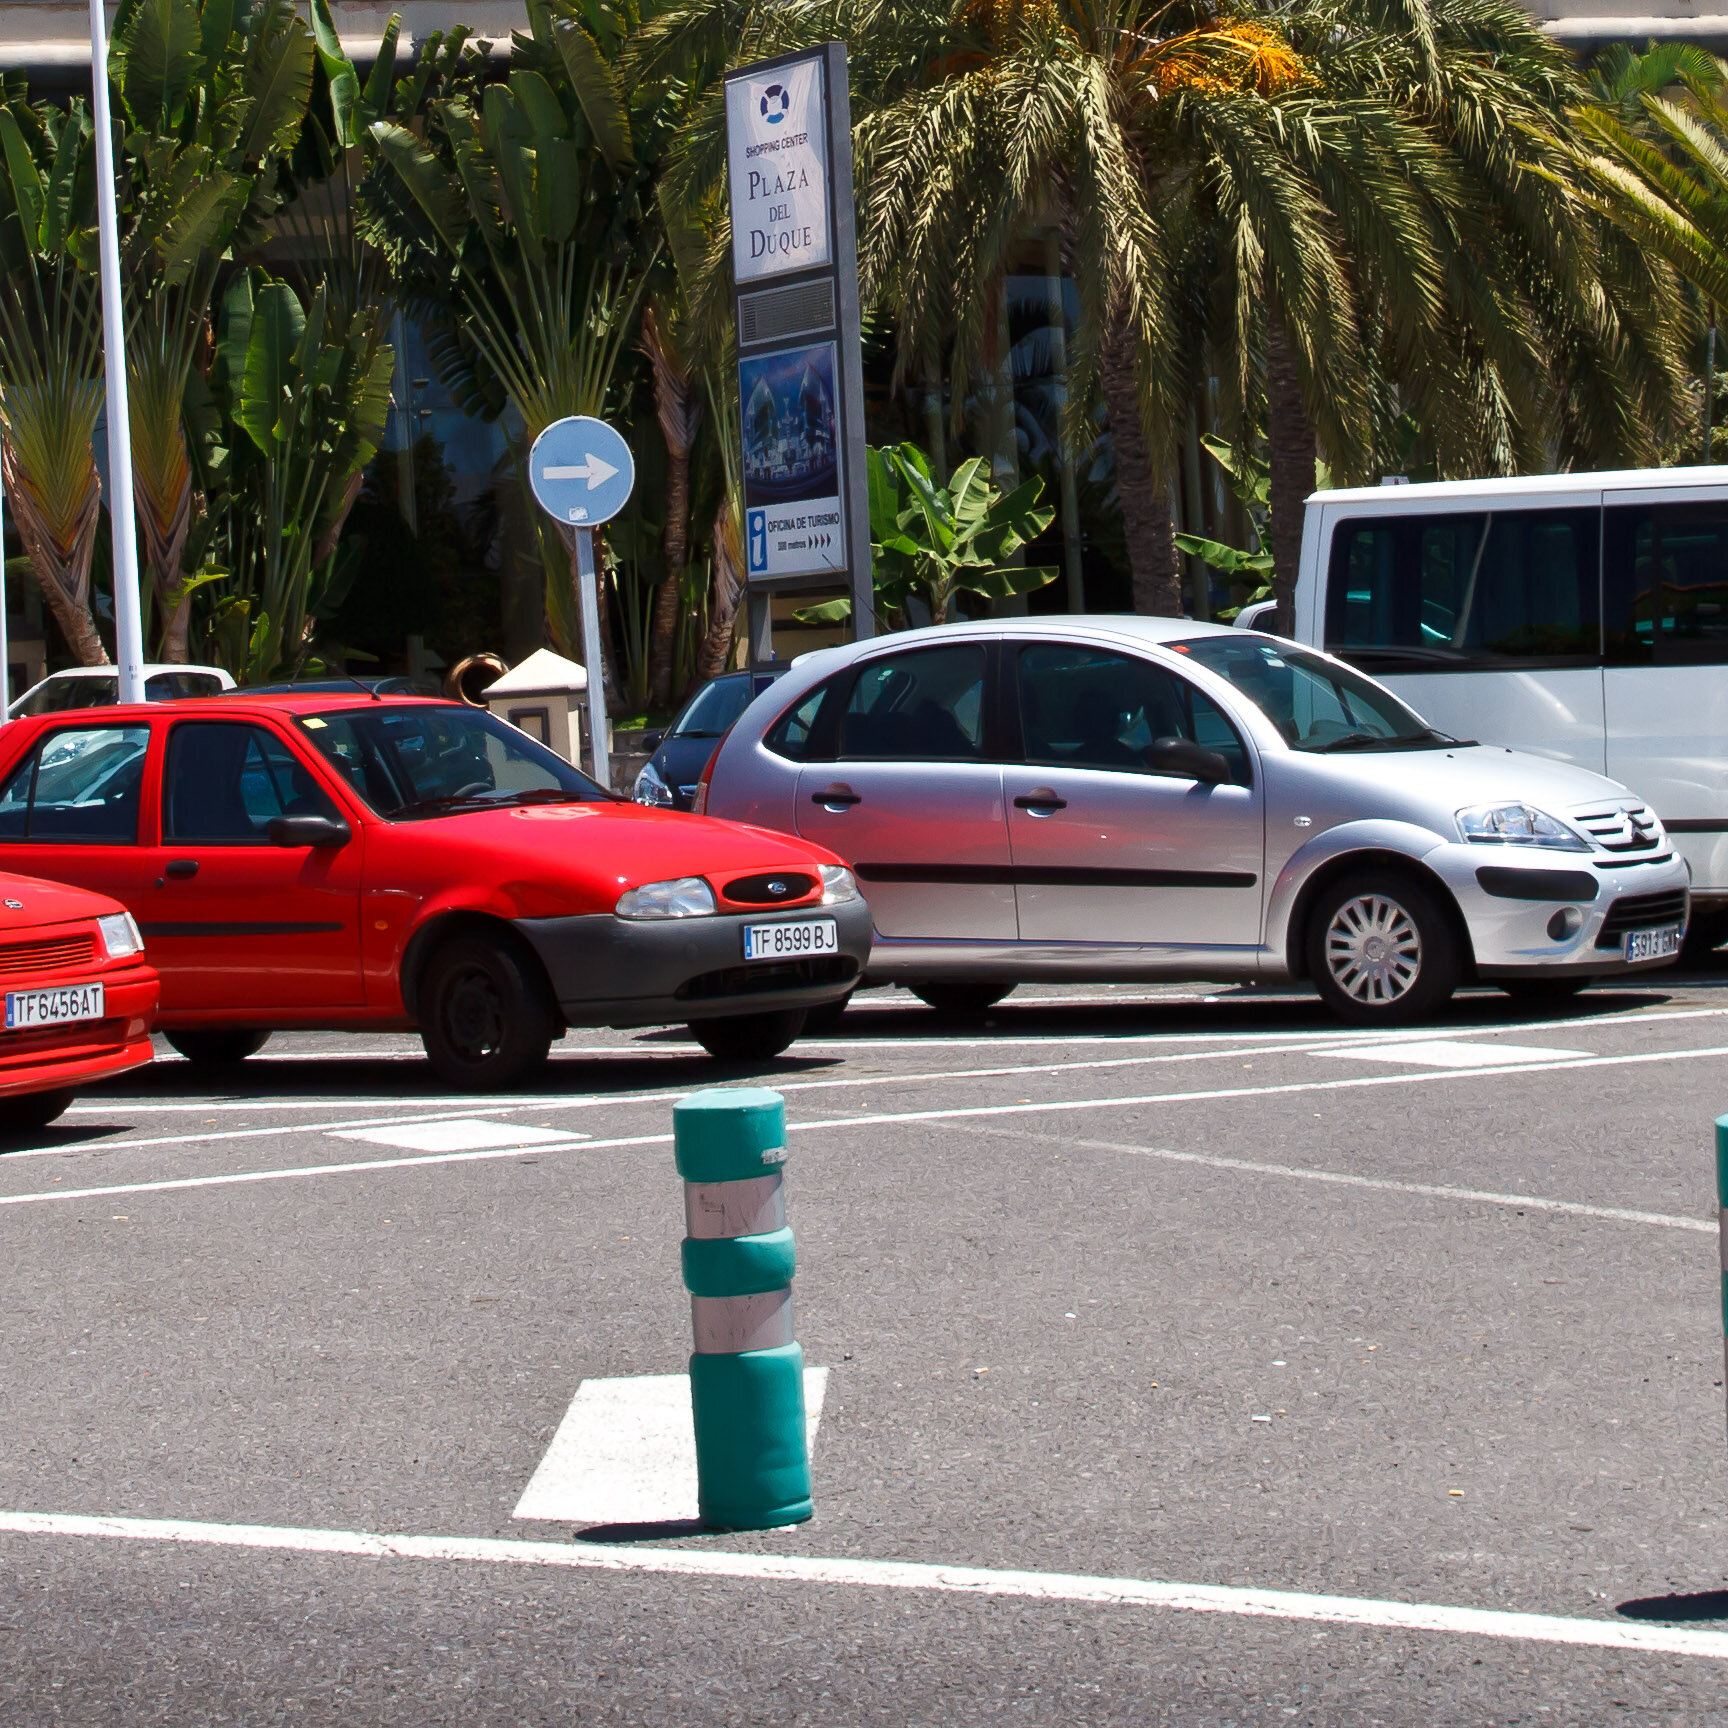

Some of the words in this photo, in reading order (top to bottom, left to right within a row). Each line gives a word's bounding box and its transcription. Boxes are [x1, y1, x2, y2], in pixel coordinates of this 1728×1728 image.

[746, 140, 780, 159] SHOPPING
[781, 133, 808, 149] CENTER
[748, 168, 809, 200] PLAZA
[769, 204, 791, 223] DEL
[750, 227, 812, 258] DUQUE
[768, 519, 795, 532] OFICINA
[797, 517, 806, 529] DE
[808, 513, 839, 527] TURISMO
[753, 929, 770, 954] TF
[775, 926, 810, 952] 8599
[815, 924, 834, 949] BJ
